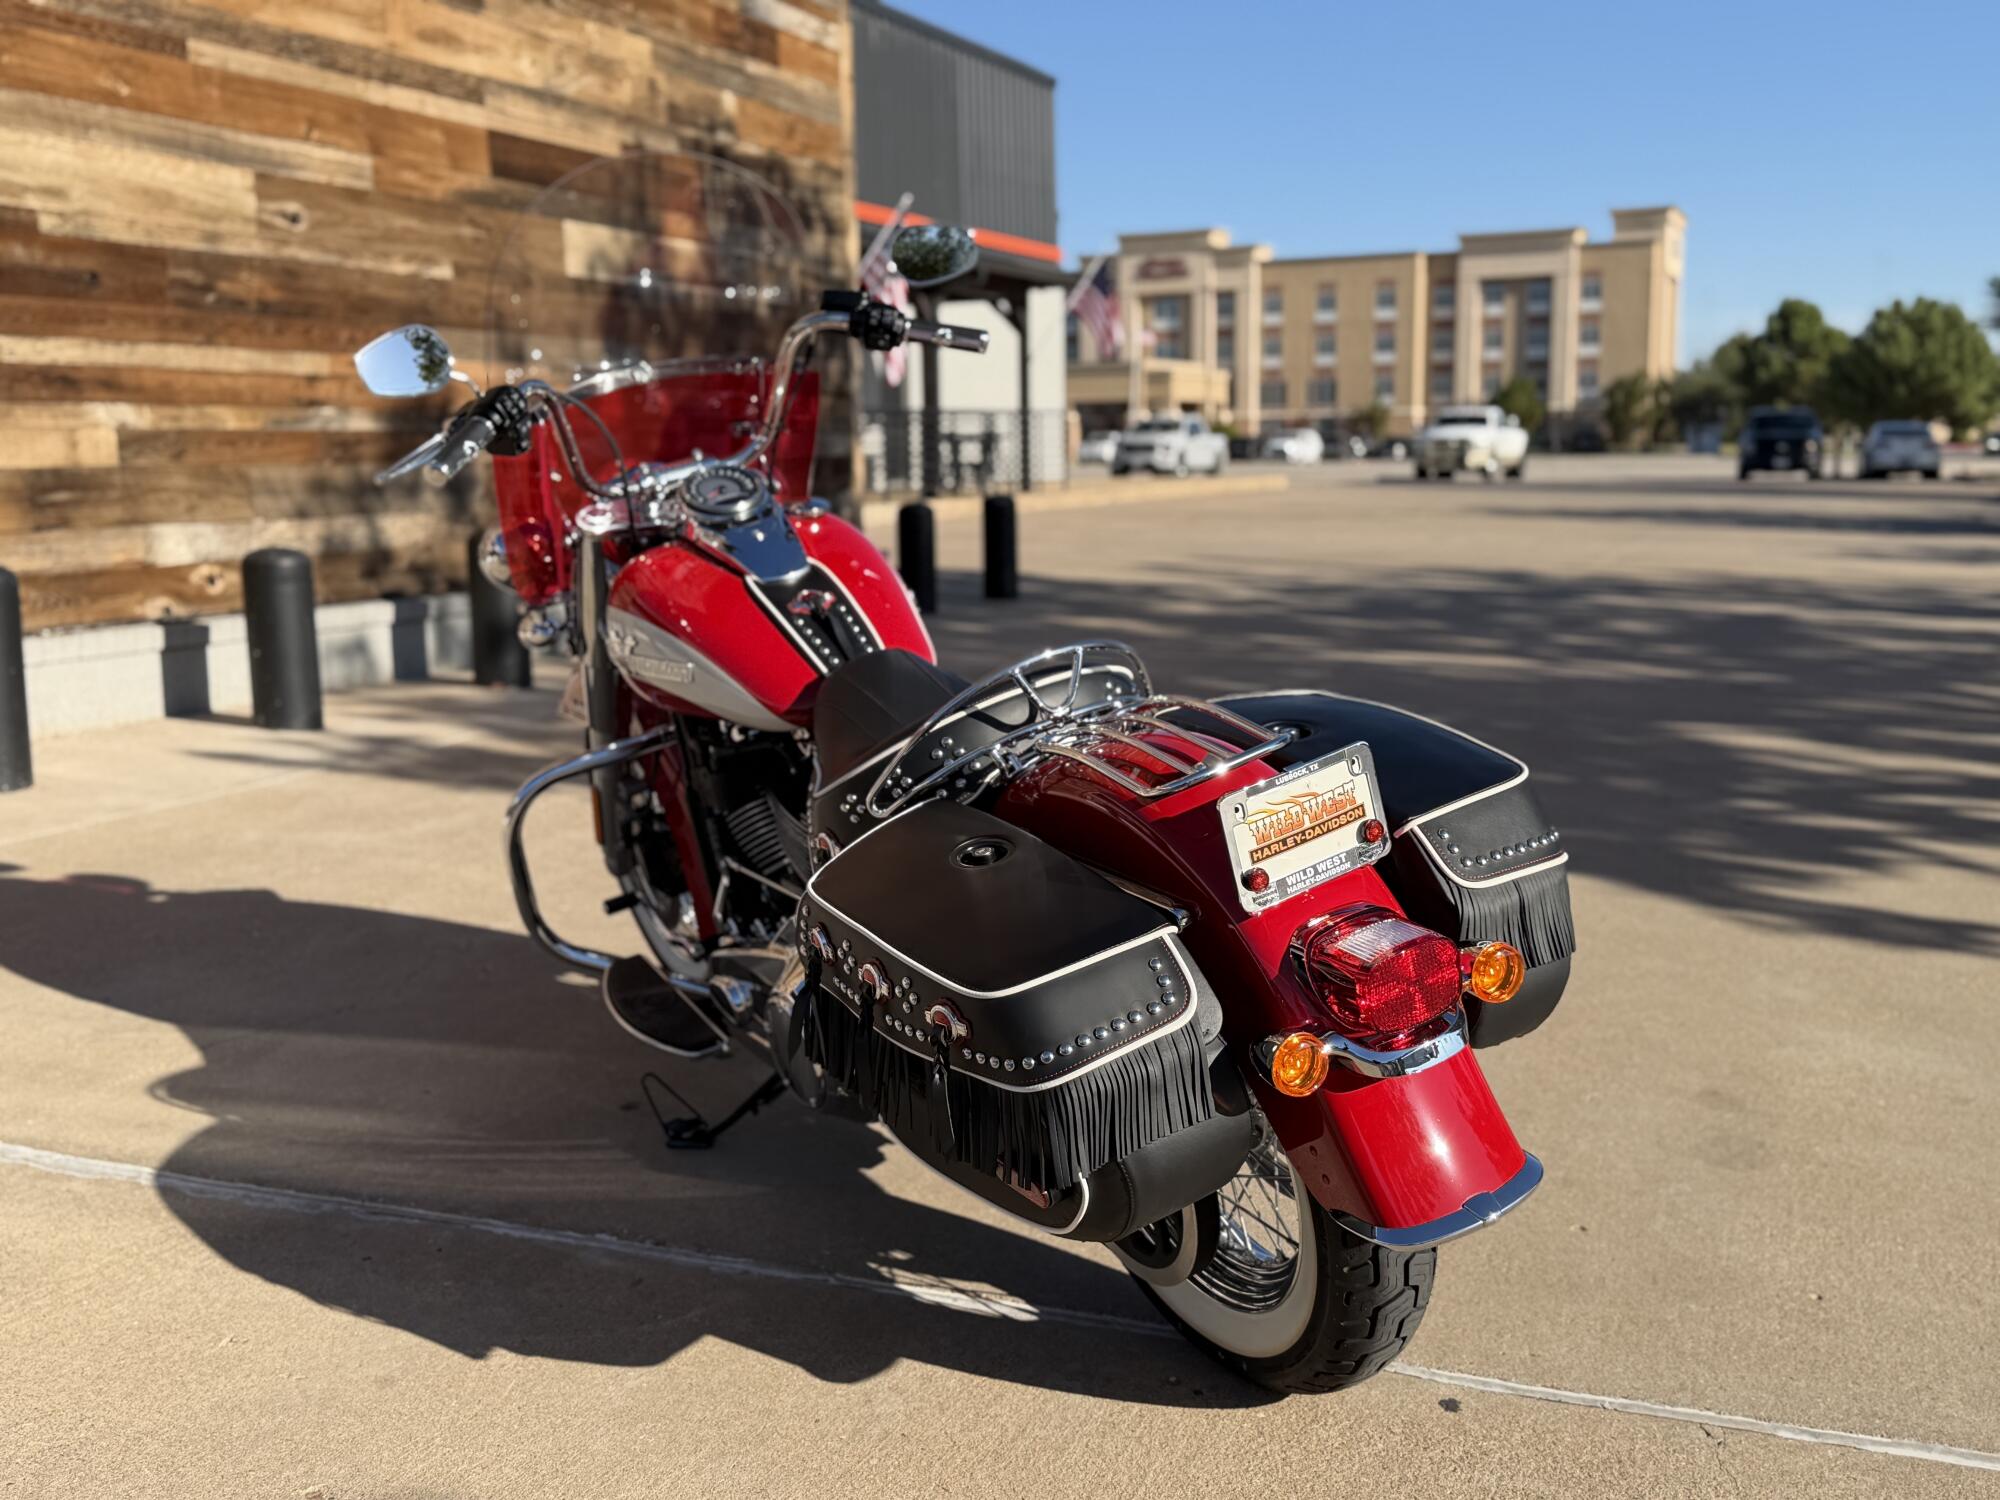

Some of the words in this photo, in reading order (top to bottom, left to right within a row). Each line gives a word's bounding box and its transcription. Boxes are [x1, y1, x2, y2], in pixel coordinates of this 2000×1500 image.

[1275, 767, 1309, 785] LUBBOCK,
[1309, 763, 1320, 773] TX
[1248, 804, 1305, 846] WILD
[1303, 780, 1357, 824] WEST
[1252, 806, 1364, 862] HARLEY-DAVIDSON
[1286, 868, 1315, 886] WILD
[1317, 853, 1347, 872] WEST
[1287, 862, 1351, 895] HARLEY-DAVIDSON
